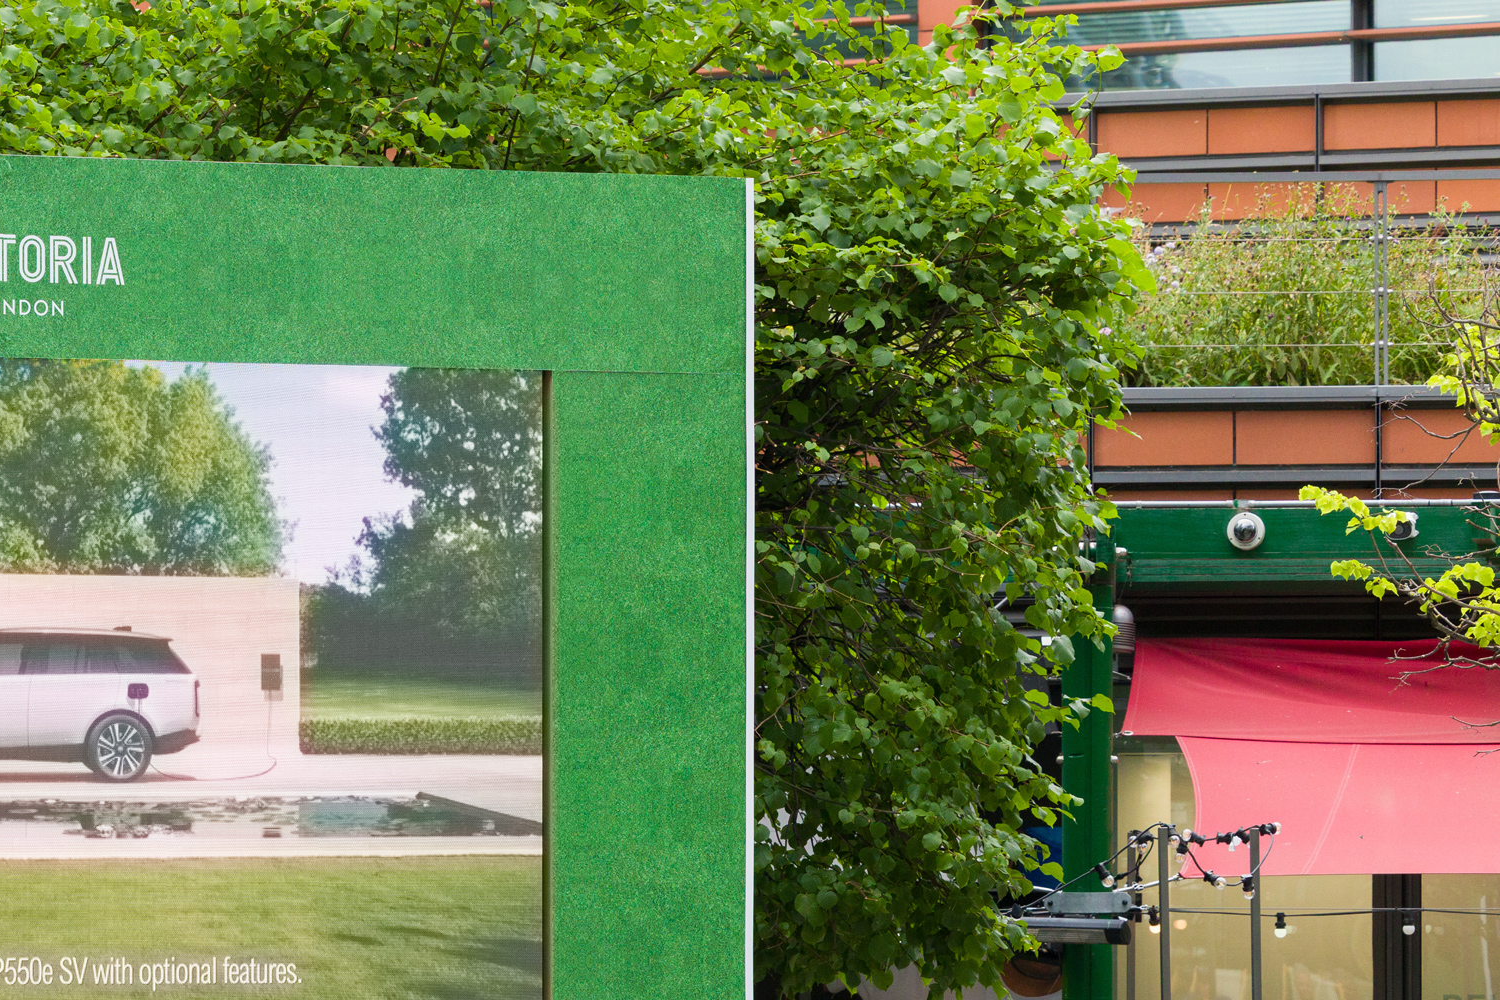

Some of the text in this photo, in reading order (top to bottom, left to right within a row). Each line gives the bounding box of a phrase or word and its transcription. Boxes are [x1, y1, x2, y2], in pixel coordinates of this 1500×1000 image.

[59, 956, 89, 986] SV
[92, 956, 134, 986] with
[138, 956, 218, 992] optional
[222, 955, 303, 985] features.
